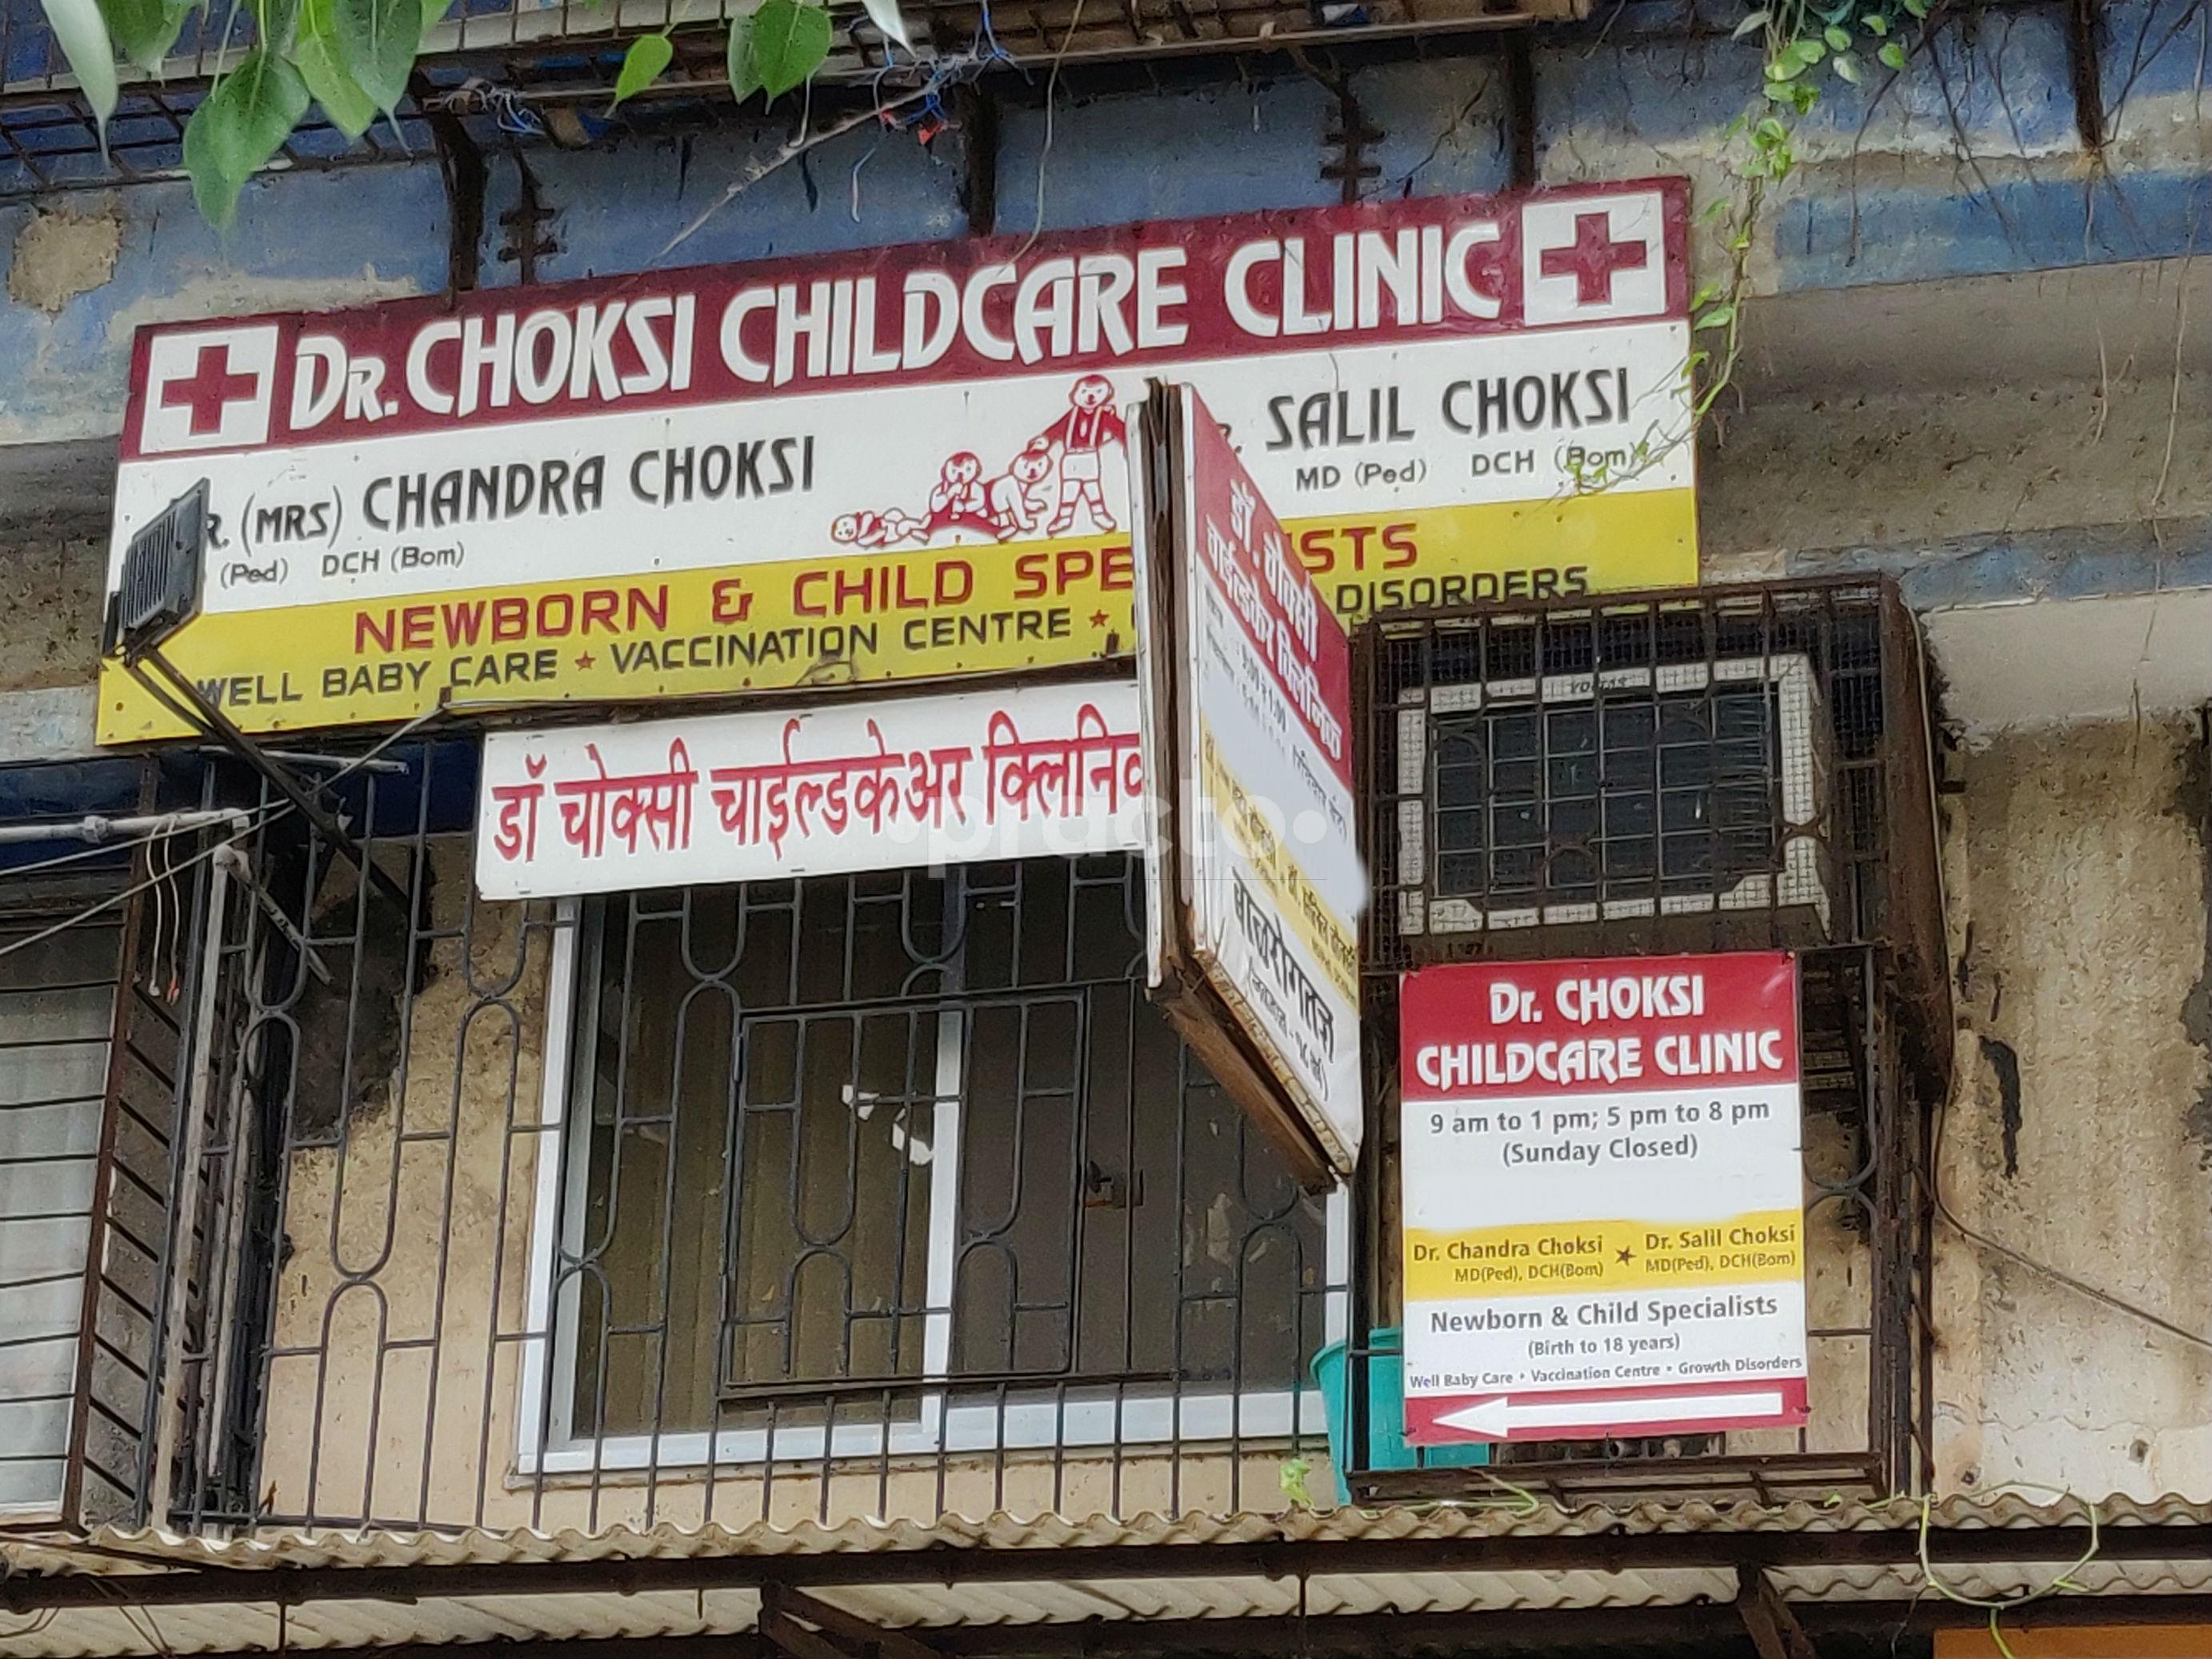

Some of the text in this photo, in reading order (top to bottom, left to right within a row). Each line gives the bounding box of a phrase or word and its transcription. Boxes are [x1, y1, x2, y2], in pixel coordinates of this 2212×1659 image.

[406, 294, 697, 418] CHOKSI
[720, 246, 1190, 388] CHILDCARE
[1225, 222, 1502, 337] CLINIC
[1266, 386, 1415, 451] SALIL
[1442, 367, 1630, 437] CHOKSI
[1295, 466, 1341, 491] MD
[1354, 458, 1427, 486] (Ped)
[1472, 450, 1534, 477] DCH
[241, 486, 342, 557] (MRS)
[363, 455, 605, 534] CHANDRA
[630, 435, 814, 510] CHOKSI
[221, 541, 465, 590] (Ped) DCH (Bom)
[354, 584, 669, 654] NEWBORN
[711, 579, 753, 625] &
[793, 560, 974, 618] CHILD
[1336, 566, 1588, 615] DISORDERS
[197, 607, 1072, 710] WELL BABY CARE VACCINATION CENTRE
[491, 753, 547, 862] डॉ
[554, 736, 700, 858] चोक्सी
[709, 718, 974, 861] चाईल्डकेअर
[1489, 975, 1705, 1025] Dr. CHOKSI
[1416, 1029, 1783, 1091] CHILDCARE CLINIC
[1430, 1101, 1769, 1134] 9 am to 1 pm; 5 pm to 8 pm
[1502, 1133, 1698, 1167] (Sunday Closed)
[1413, 1234, 1603, 1262] Dr. Chandra Choksi
[1645, 1223, 1796, 1251] Dr. Salil Choksi
[1528, 1260, 1603, 1280] DCH(Bom)
[1719, 1250, 1796, 1270] DCH(Bom)
[1430, 1294, 1778, 1333] Newborn & Child Specialists
[1527, 1333, 1681, 1359] (Birth to 18 years)
[1410, 1355, 1802, 1389] Well Baby Care Vaccination Centre Growth Disorders
